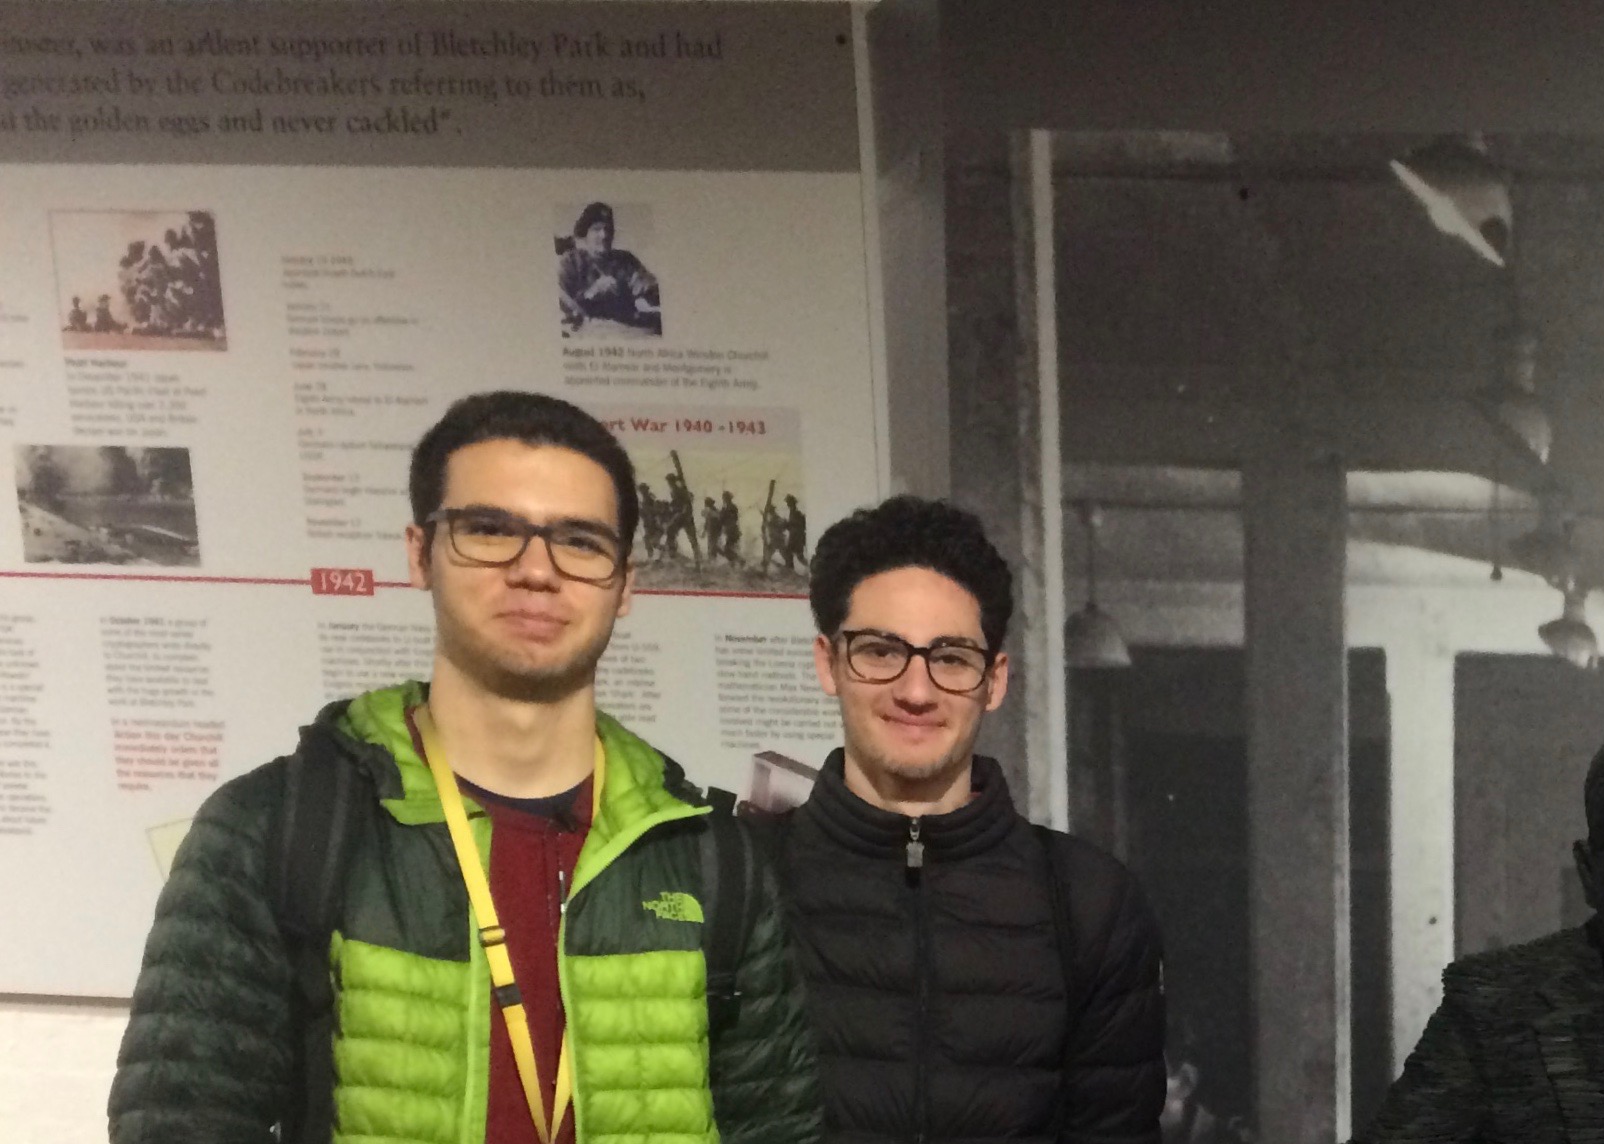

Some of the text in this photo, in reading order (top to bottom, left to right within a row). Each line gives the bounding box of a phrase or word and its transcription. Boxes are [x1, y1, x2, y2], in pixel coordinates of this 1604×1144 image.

[621, 33, 665, 58] and
[677, 31, 723, 60] had
[213, 67, 382, 97] Codebreakers
[506, 75, 531, 98] to
[218, 107, 263, 134] and
[275, 115, 337, 134] never
[631, 418, 667, 434] War
[675, 419, 712, 435] 1940
[319, 572, 368, 592] 1942
